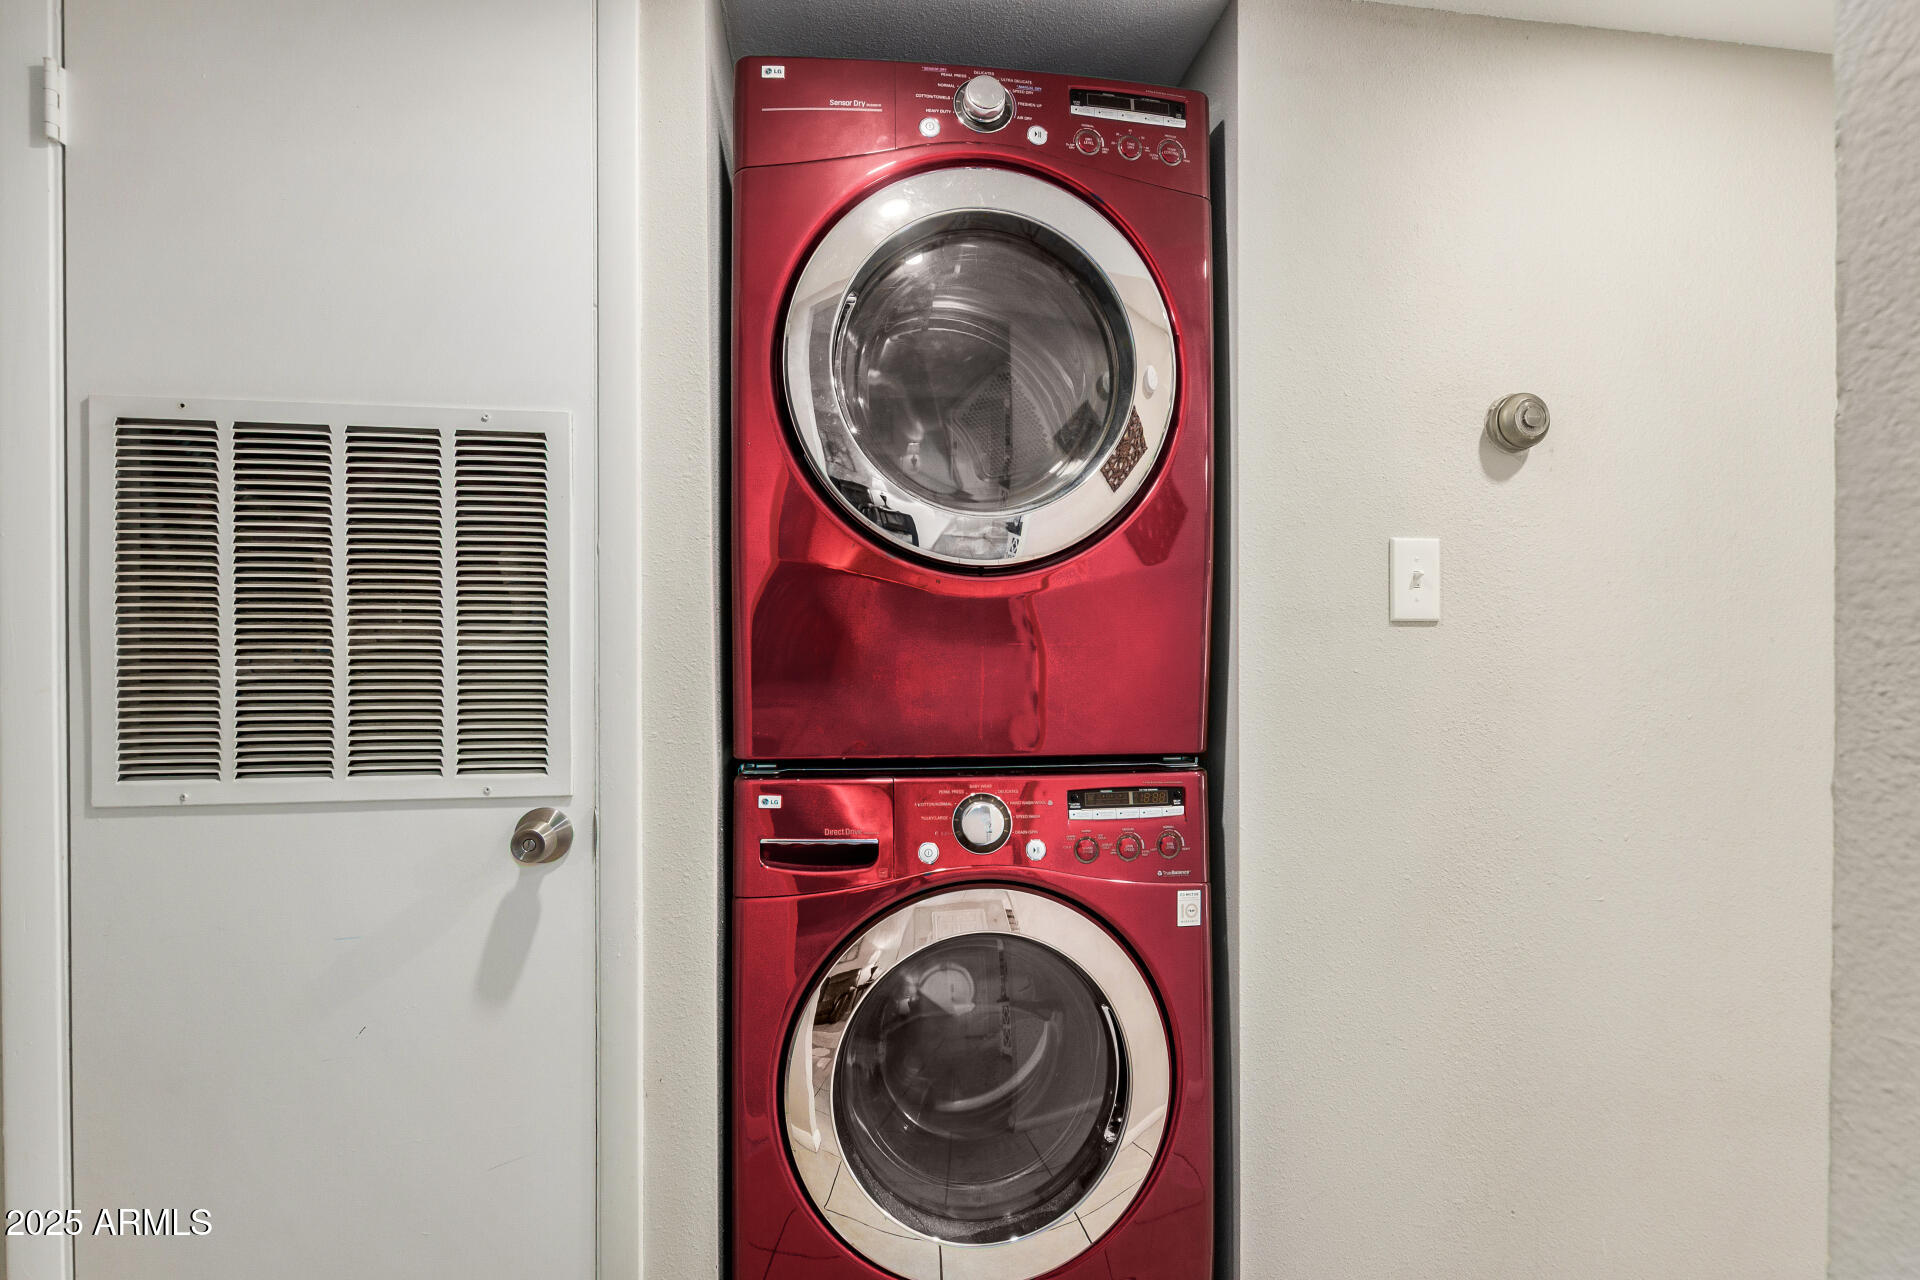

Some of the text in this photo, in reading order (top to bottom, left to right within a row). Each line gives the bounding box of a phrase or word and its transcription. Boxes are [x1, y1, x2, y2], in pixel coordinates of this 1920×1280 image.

[829, 99, 853, 107] Sensor
[853, 99, 866, 107] Dry
[824, 828, 845, 836] Direct
[845, 828, 863, 836] Drive
